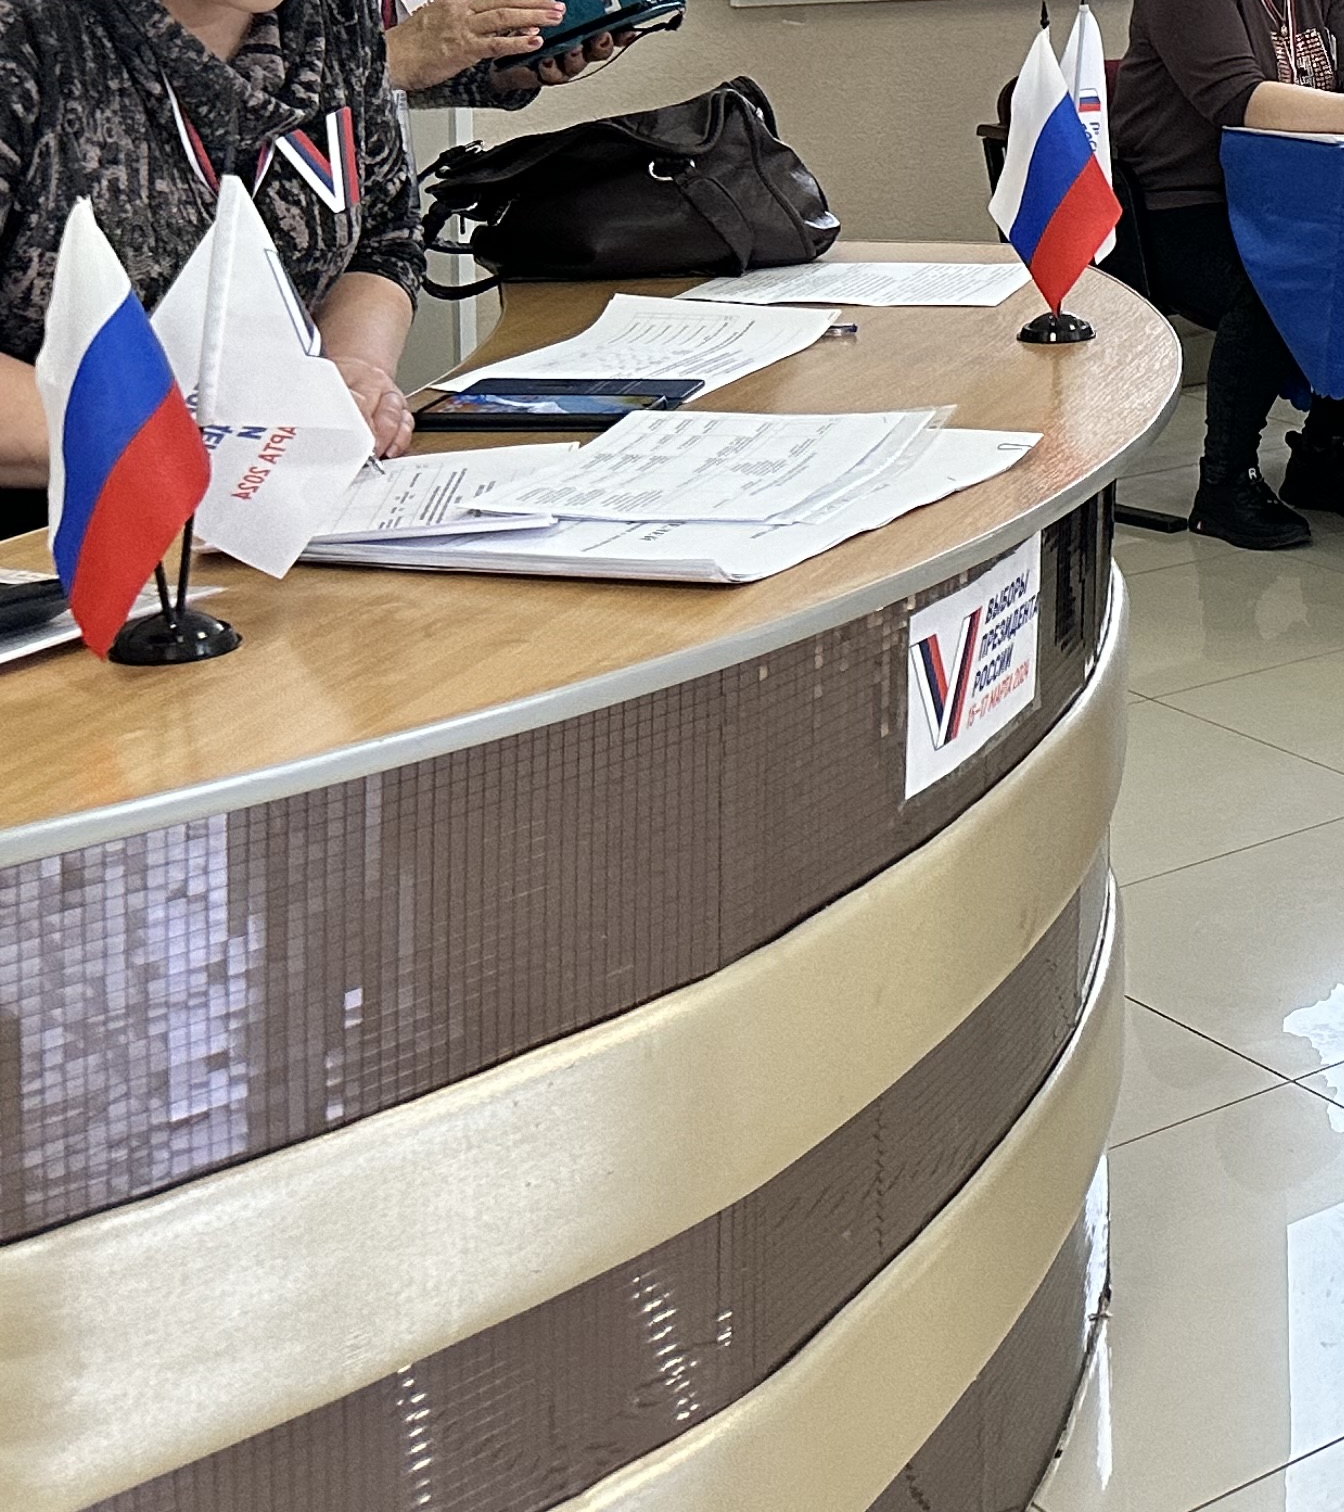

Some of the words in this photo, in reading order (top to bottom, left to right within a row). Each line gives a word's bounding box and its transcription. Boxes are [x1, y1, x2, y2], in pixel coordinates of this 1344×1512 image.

[985, 569, 1030, 624] ВЫБОРЫ
[978, 594, 1039, 662] ПРЕЗИДЕНТА
[972, 641, 1015, 698] РОССИИ
